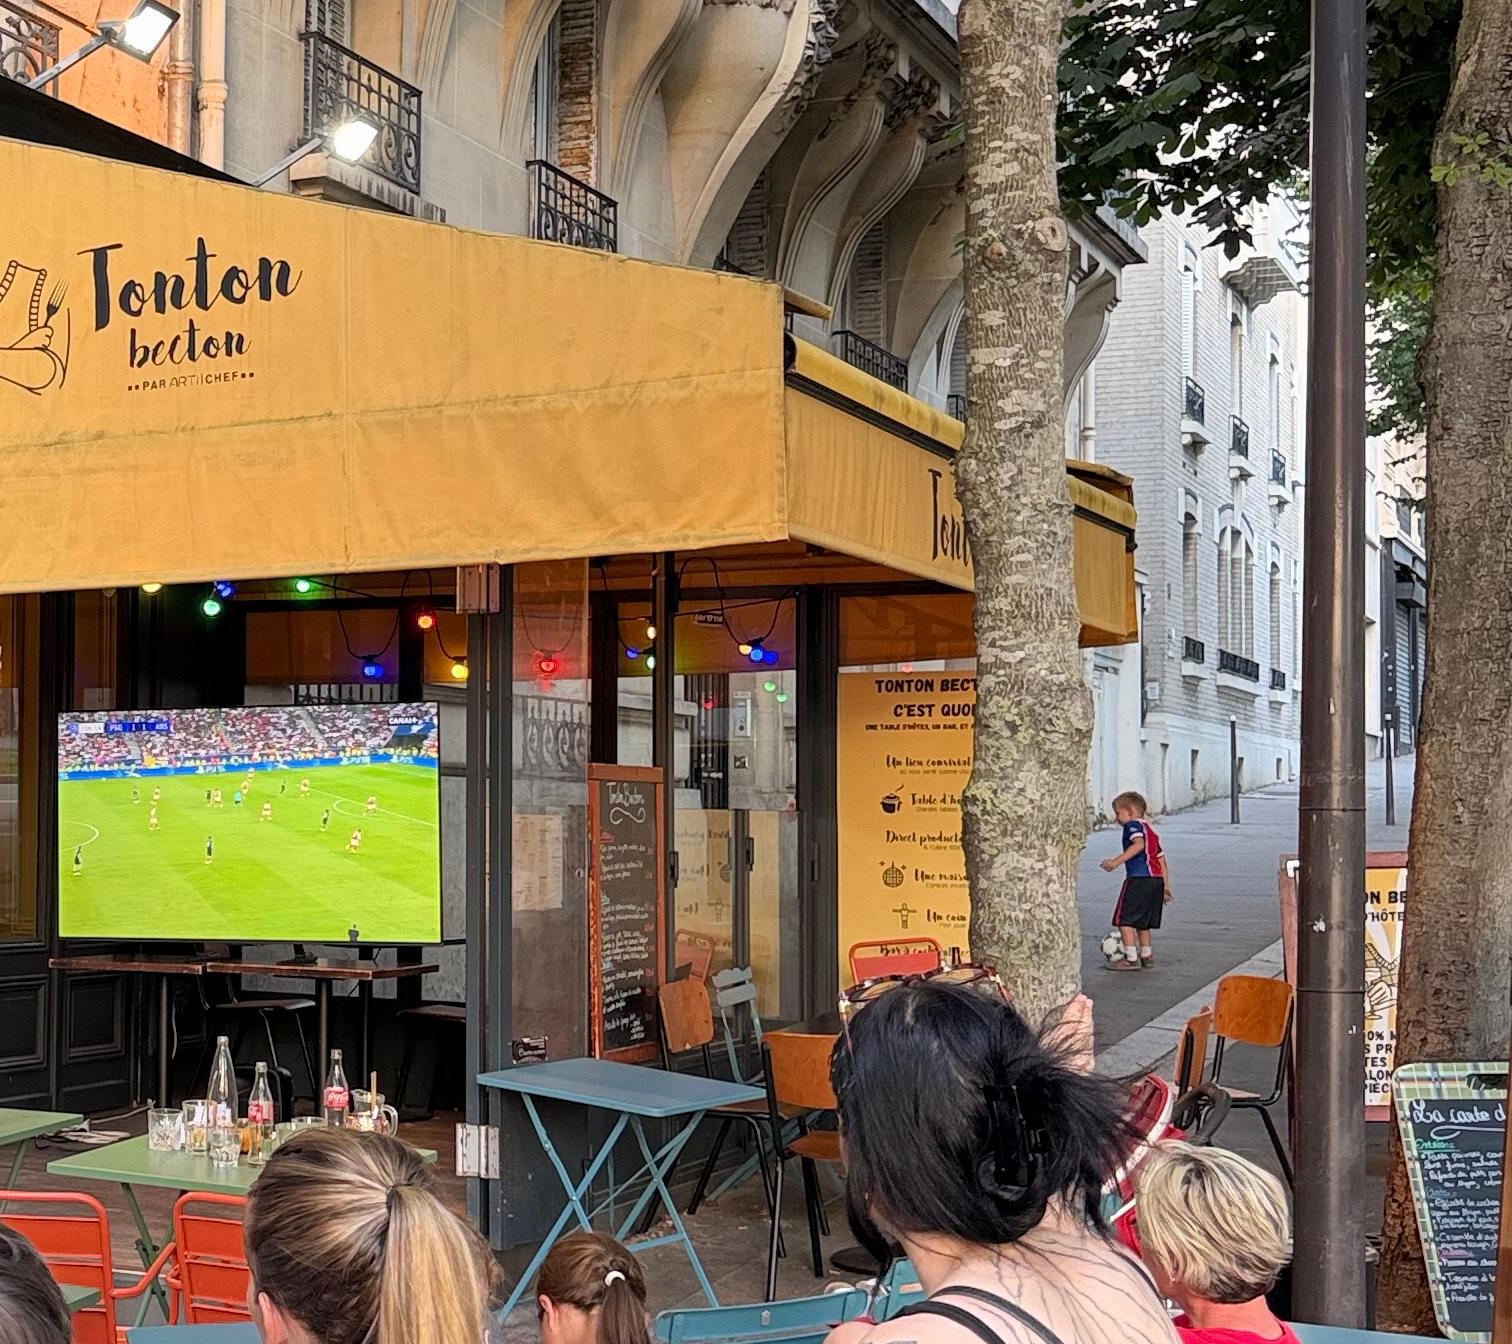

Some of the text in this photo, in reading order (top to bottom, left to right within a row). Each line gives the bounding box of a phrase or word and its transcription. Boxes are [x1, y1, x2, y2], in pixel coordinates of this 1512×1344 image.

[76, 236, 303, 332] Tonton
[129, 318, 251, 369] becton
[142, 378, 166, 391] PAR
[875, 678, 934, 693] TONTON
[893, 704, 935, 717] C'EST
[910, 793, 937, 805] Table
[886, 829, 916, 843] Direct
[915, 868, 935, 882] Une
[927, 908, 942, 923] Un
[1365, 908, 1405, 922] 'HÔTE
[1412, 1099, 1446, 1124] La
[1449, 1105, 1491, 1124] carte
